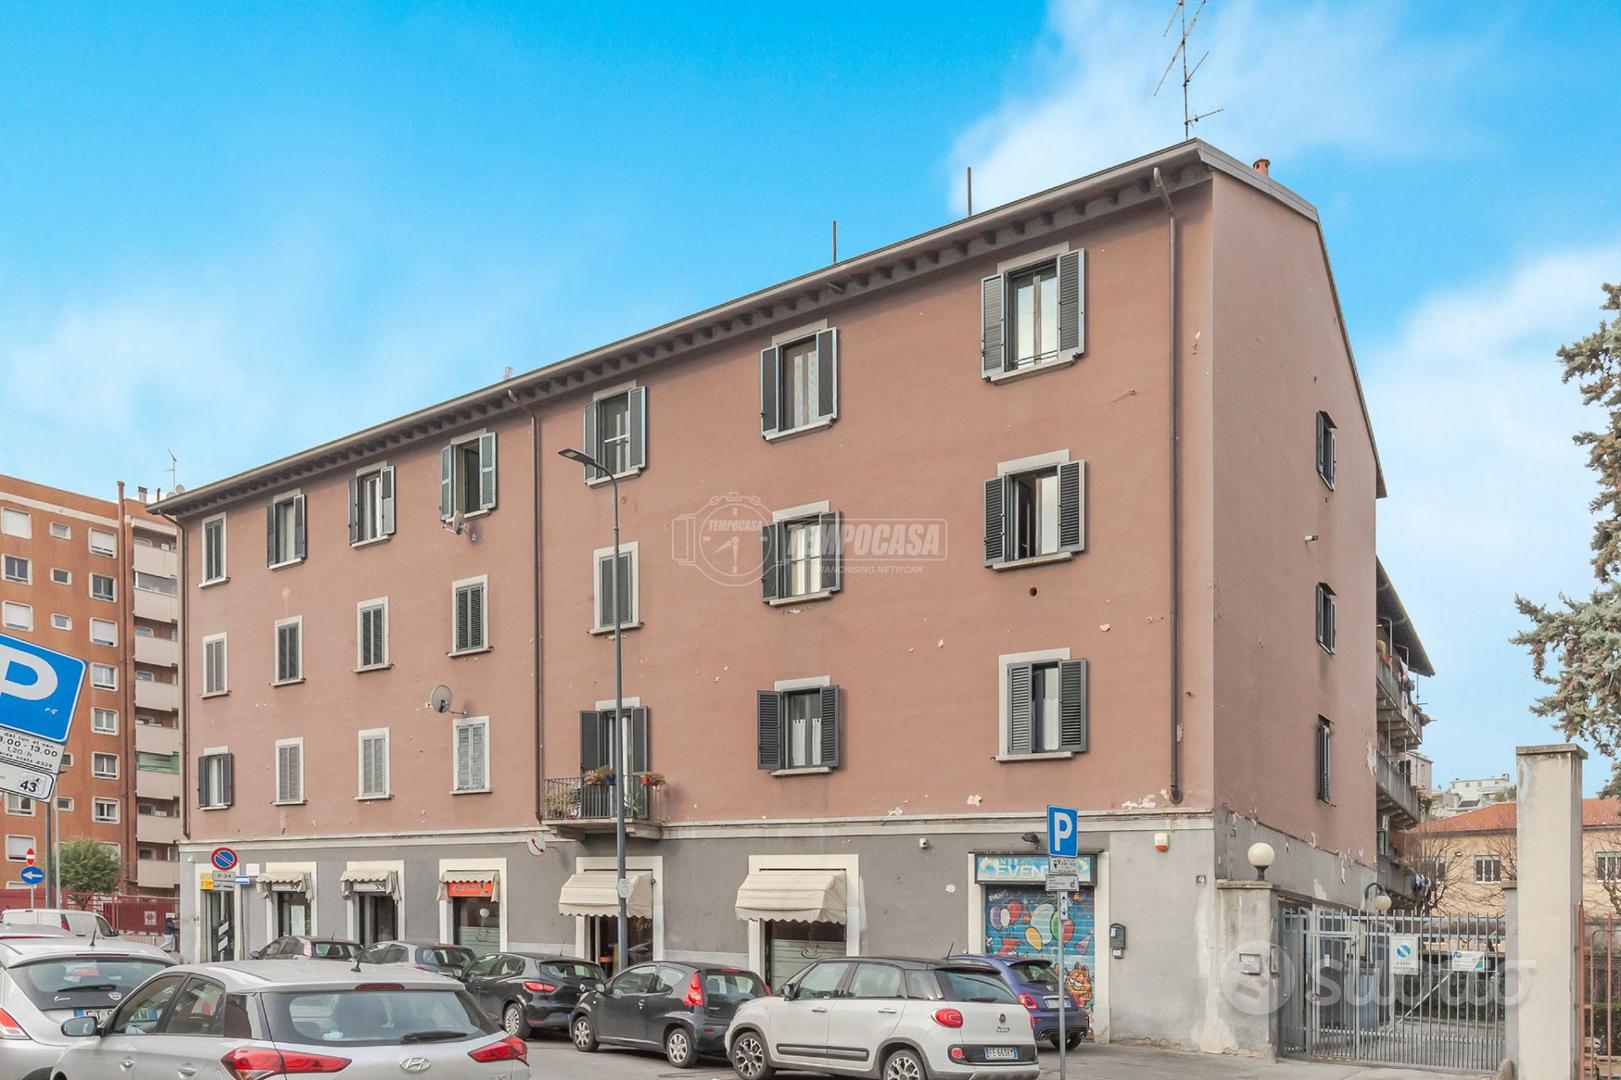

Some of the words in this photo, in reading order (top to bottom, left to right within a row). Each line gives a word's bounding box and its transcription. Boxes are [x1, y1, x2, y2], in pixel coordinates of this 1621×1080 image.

[0, 643, 58, 700] P
[20, 780, 37, 793] 43
[1054, 812, 1072, 851] P
[998, 865, 1048, 879] EVEN
